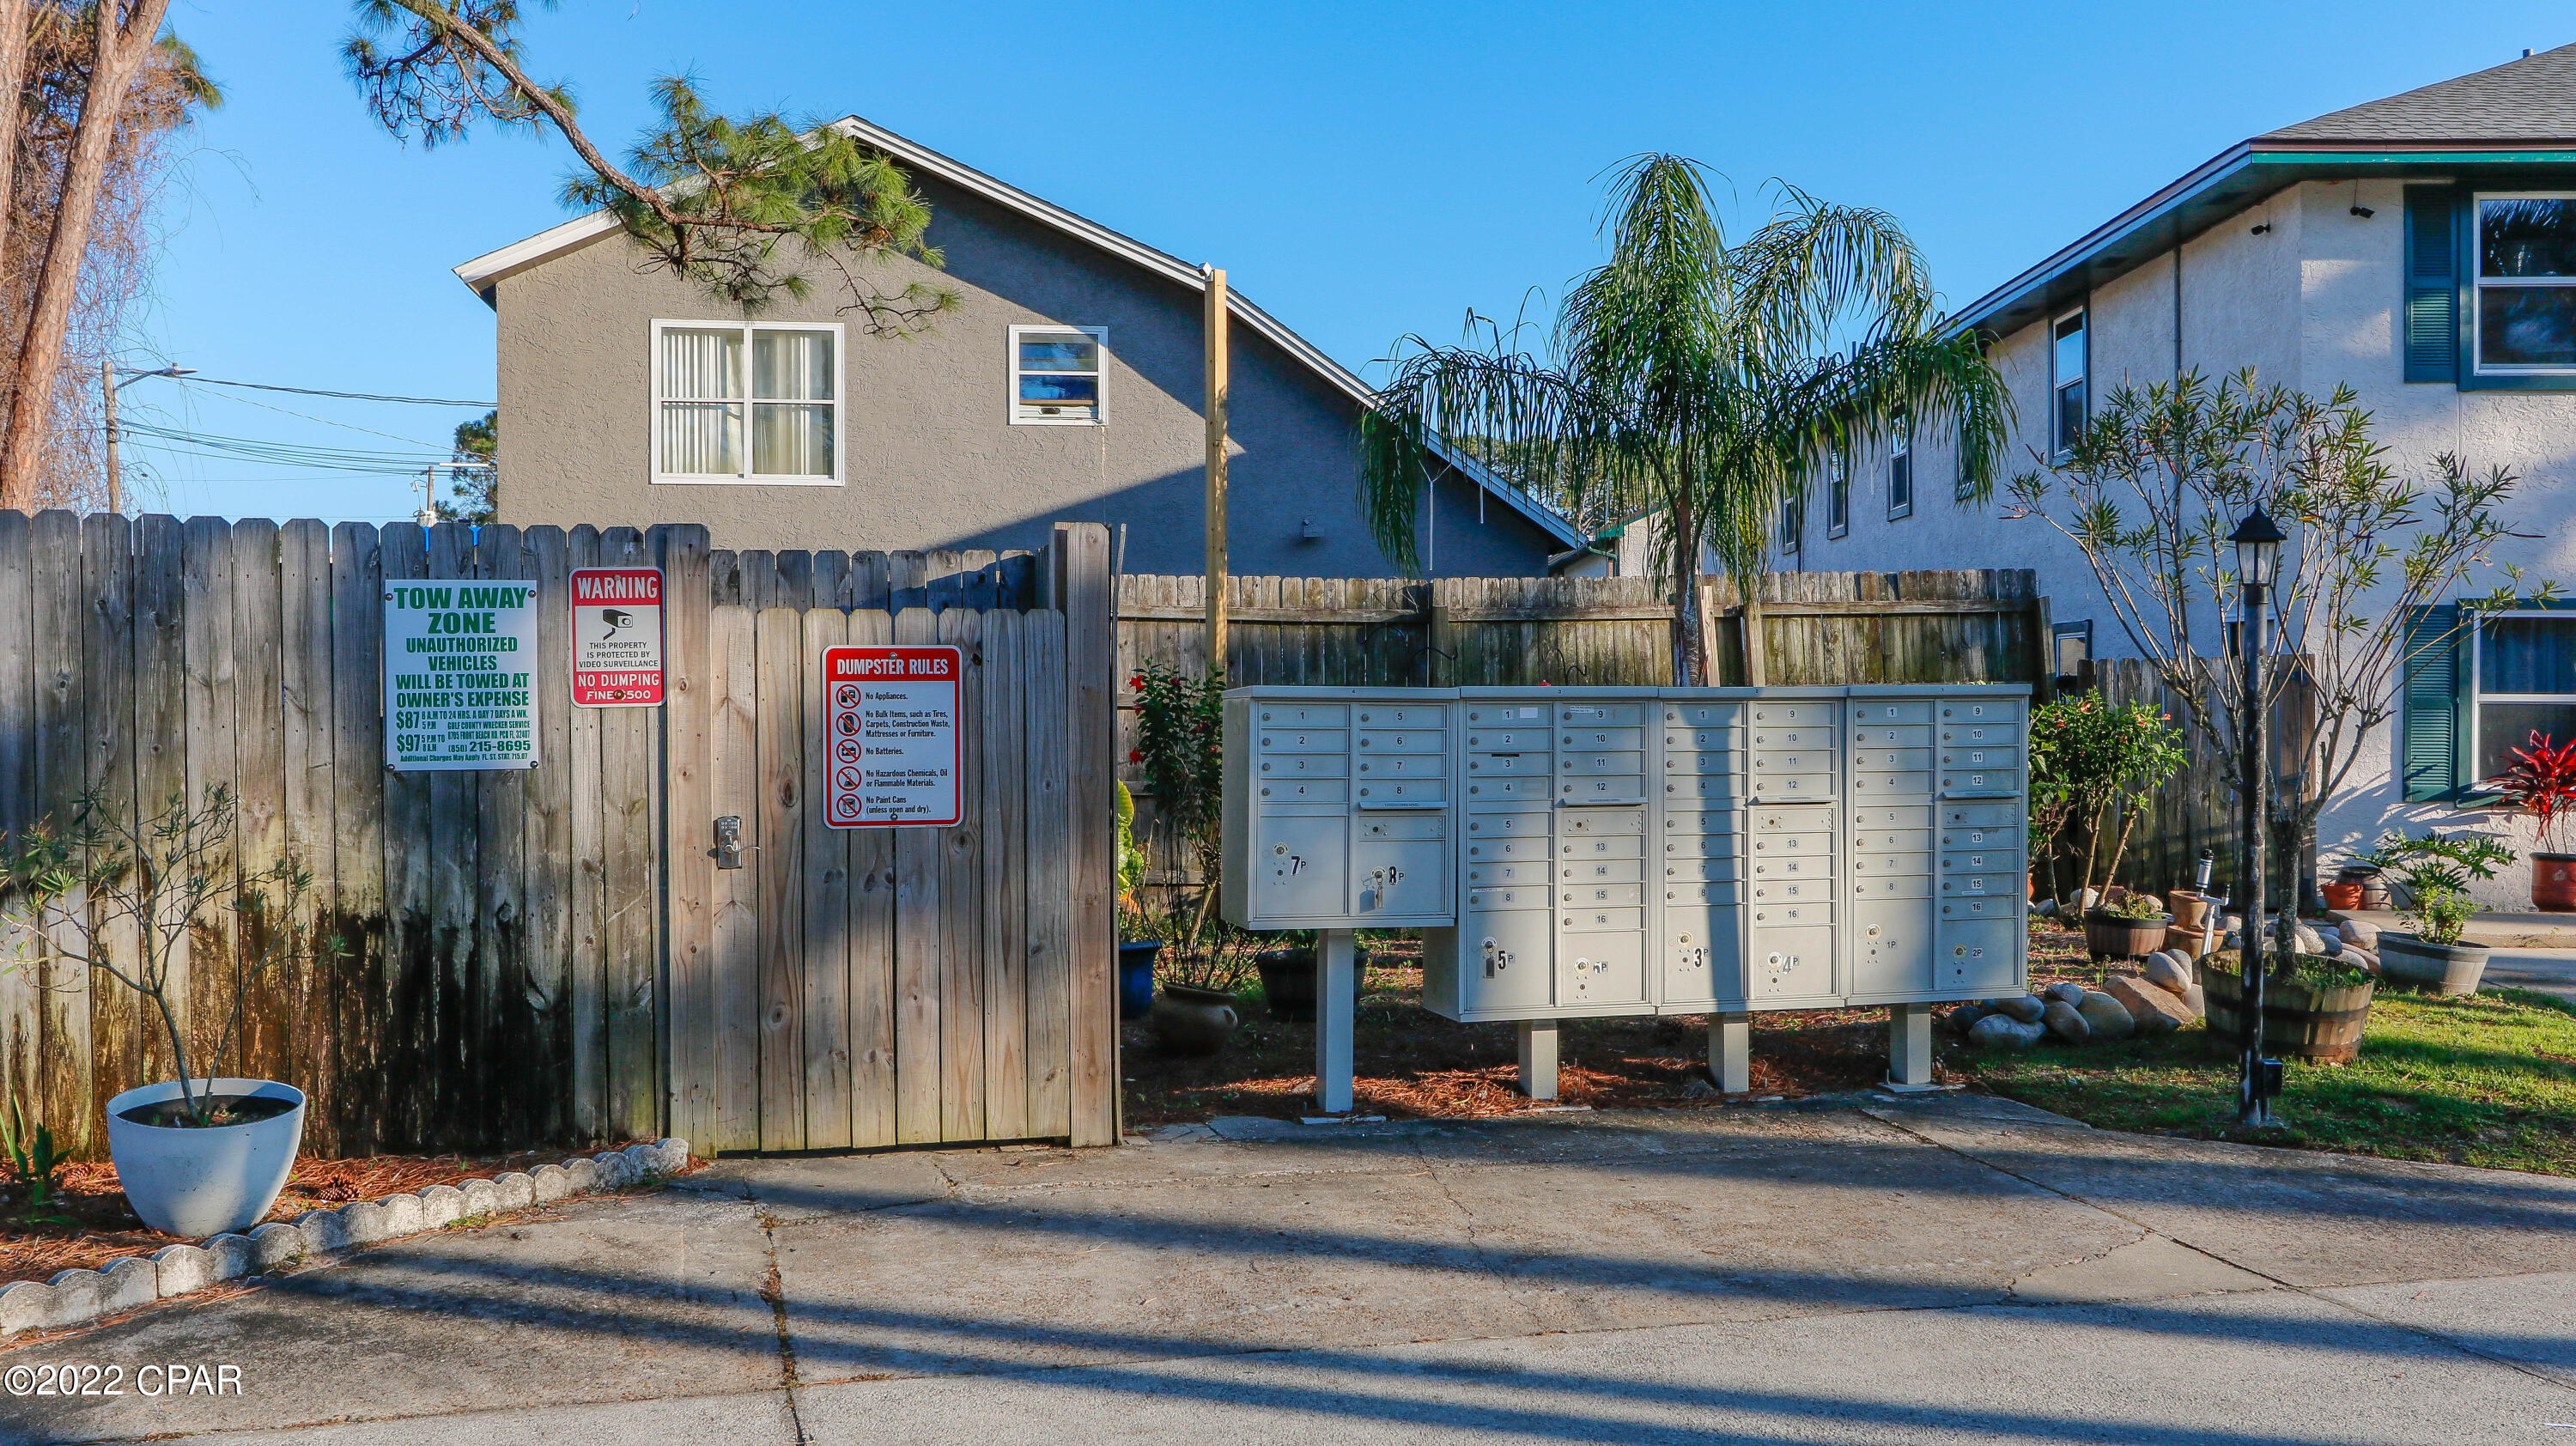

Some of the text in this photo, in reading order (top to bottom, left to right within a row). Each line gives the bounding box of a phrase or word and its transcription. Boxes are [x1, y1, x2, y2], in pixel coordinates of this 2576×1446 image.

[577, 577, 659, 599] WARNING
[393, 587, 528, 609] TOW AWAY
[428, 612, 495, 634] ZONE
[406, 637, 517, 653] UNAUTHORIZED
[428, 655, 497, 671] VEHICLES
[837, 659, 948, 675] DUMPSTER RULES
[395, 673, 529, 690] WILL BE TOWED AT
[579, 673, 659, 687] NO DUMPING
[397, 691, 529, 708] OWNER'S EXPENSE
[586, 690, 614, 701] FINE
[875, 692, 908, 701] Appliances.
[448, 709, 528, 720] 24 HRS. A DAY 7 DAYS A WK.
[890, 710, 908, 719] Items,
[933, 709, 948, 719] Tires,
[396, 710, 420, 731] $87
[447, 721, 460, 730] GULF
[866, 720, 890, 729] Carpets,
[931, 720, 950, 728] Waste,
[460, 731, 475, 739] FRONT
[475, 731, 490, 739] BEACH
[1299, 736, 1304, 744] 2
[397, 733, 420, 753] $97
[469, 740, 531, 752] 215-8695
[1299, 761, 1304, 769] 3
[908, 769, 939, 778] Chemicals,
[874, 779, 905, 787] Flammable
[907, 778, 935, 787] Materials.
[866, 805, 887, 815] (unless
[889, 807, 903, 816] open
[917, 805, 931, 814] dry).
[1701, 841, 1707, 850] 6
[1596, 866, 1606, 875] 14
[1701, 865, 1707, 874] 7
[1596, 890, 1606, 899] 15
